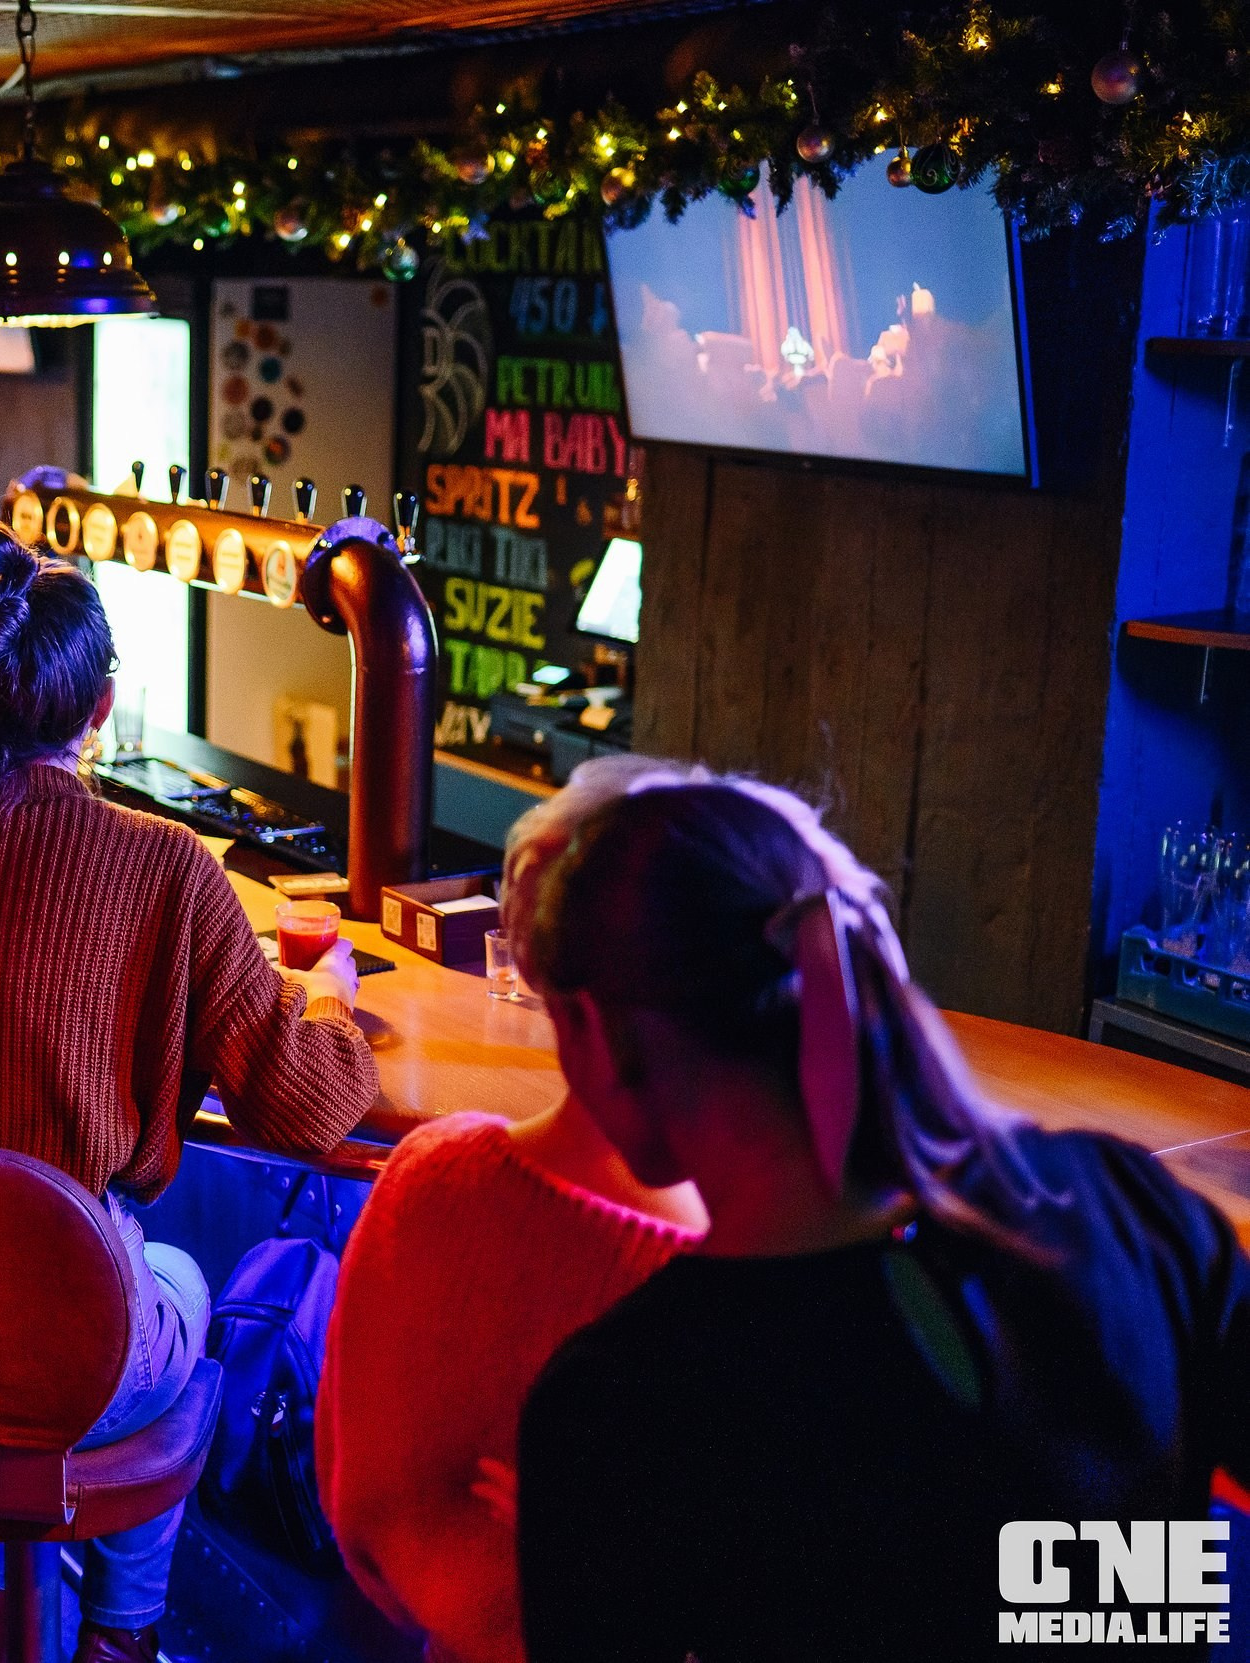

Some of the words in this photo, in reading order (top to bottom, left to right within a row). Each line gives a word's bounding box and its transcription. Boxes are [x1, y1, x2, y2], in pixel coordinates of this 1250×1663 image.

[509, 275, 579, 336] 450
[543, 411, 626, 477] BABY
[424, 463, 541, 529] SPRITZ
[444, 576, 547, 651] SUZIE
